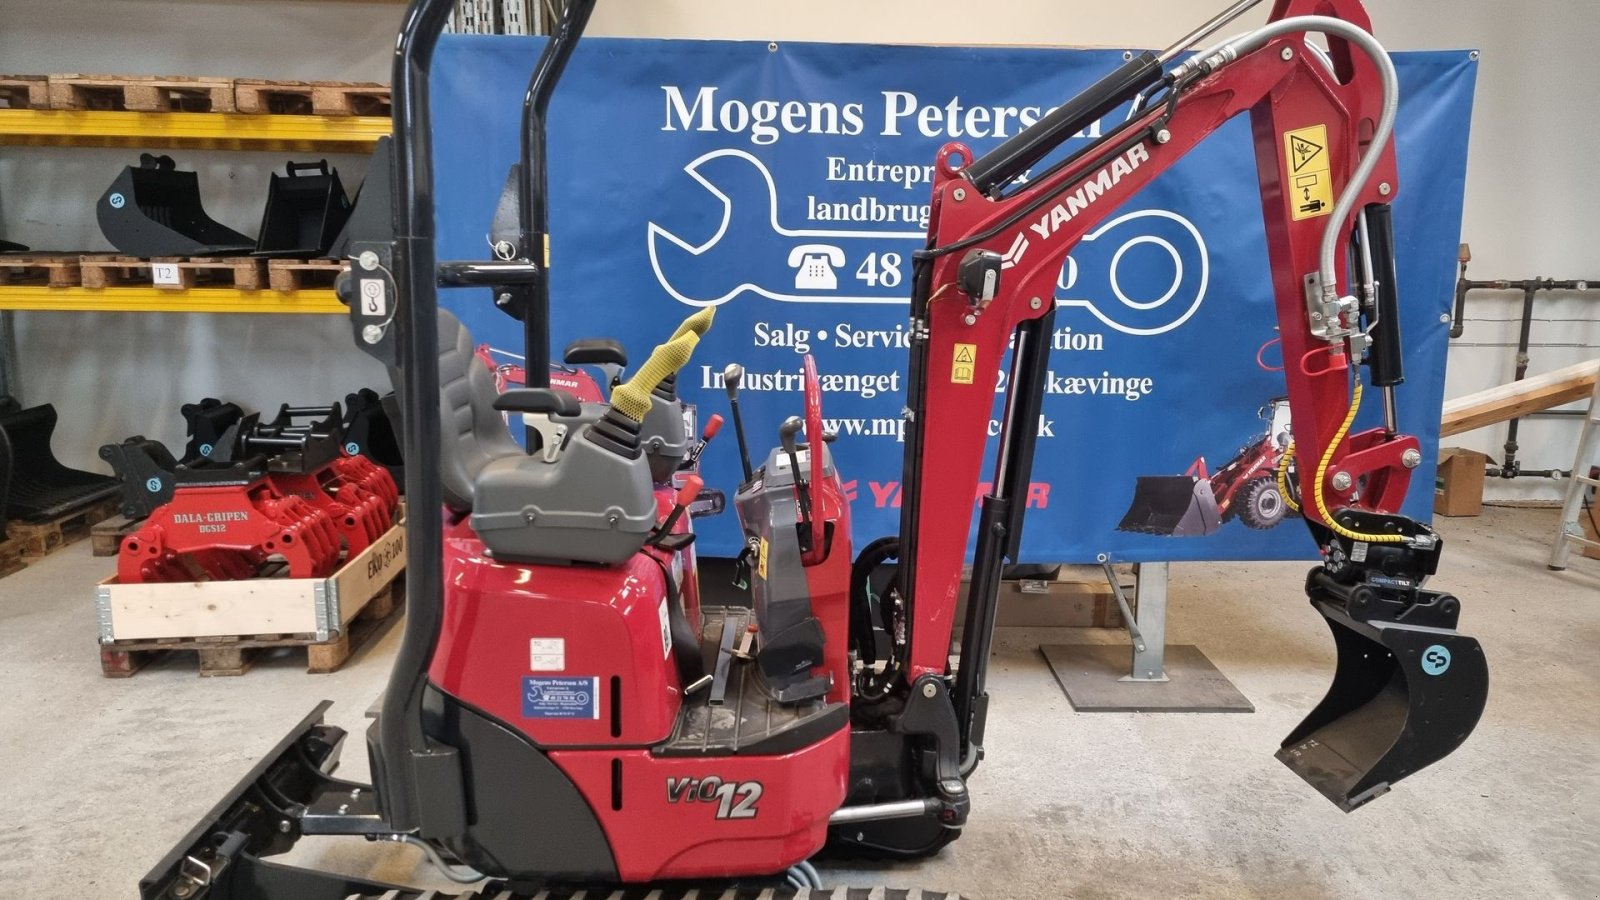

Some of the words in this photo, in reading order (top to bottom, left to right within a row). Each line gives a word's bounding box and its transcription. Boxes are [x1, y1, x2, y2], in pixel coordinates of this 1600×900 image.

[660, 85, 864, 145] Mogens
[826, 156, 936, 190] Entrepr
[1029, 141, 1150, 240] YANMAR
[807, 195, 931, 229] landbrug
[155, 267, 172, 279] T2
[855, 252, 901, 287] 48
[754, 322, 810, 354] Salg
[835, 323, 911, 348] Servic
[1044, 370, 1153, 401] kævinge
[174, 511, 249, 524] DALA-GRIPEN
